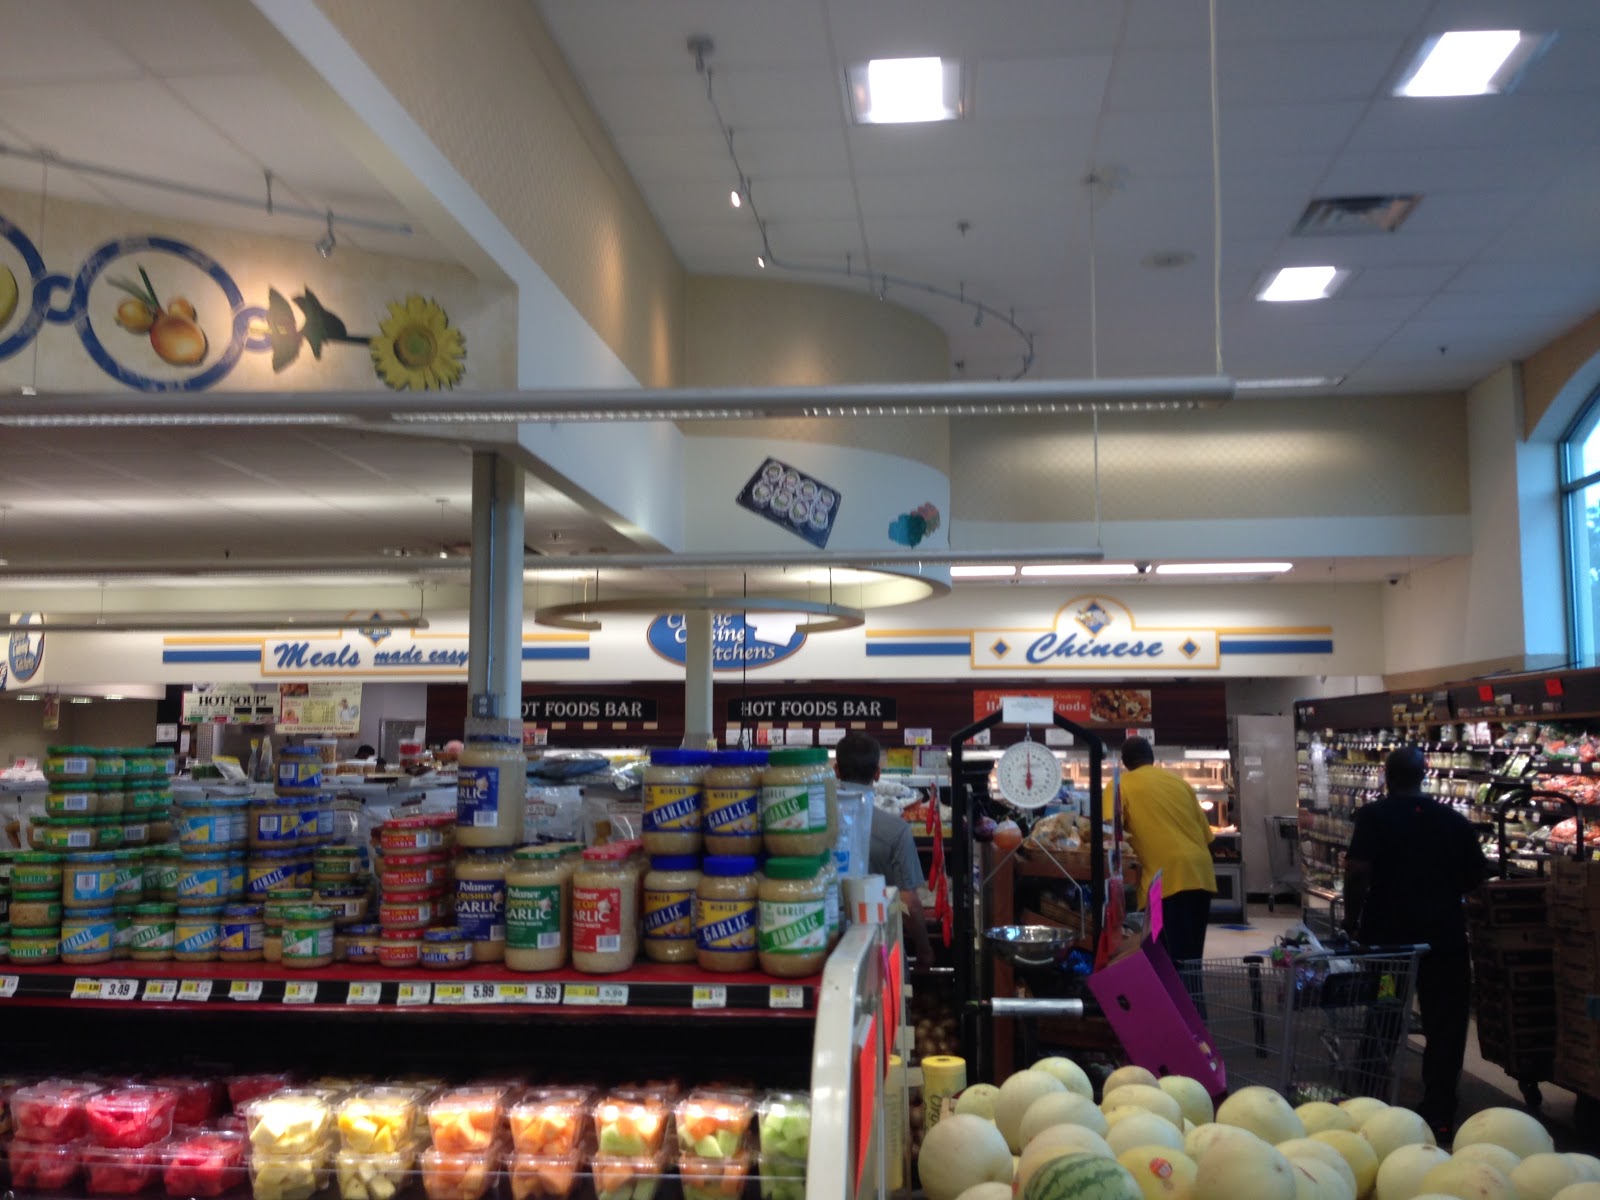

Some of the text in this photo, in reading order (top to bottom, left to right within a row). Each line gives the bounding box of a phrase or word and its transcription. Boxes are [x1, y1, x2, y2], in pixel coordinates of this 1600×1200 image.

[674, 625, 746, 643] Csine
[273, 642, 470, 669] Meals made easy
[712, 643, 776, 661] tchens
[1026, 632, 1164, 664] Chinese
[198, 694, 267, 707] HOT SOUP!
[1053, 702, 1087, 711] oods
[521, 701, 642, 717] OT FOODS BAR
[741, 701, 882, 717] HOT FOODS BAR
[652, 797, 697, 824] GARLIC
[708, 800, 751, 828] GARLIC
[460, 881, 494, 891] Polaner
[455, 901, 502, 913] GARLIC
[574, 910, 610, 922] ARLIC
[645, 903, 683, 930] ARLIC
[703, 913, 749, 942] GARLIC
[108, 983, 130, 996] 3.49
[473, 985, 495, 998] 5.99
[535, 986, 558, 1000] 5.99
